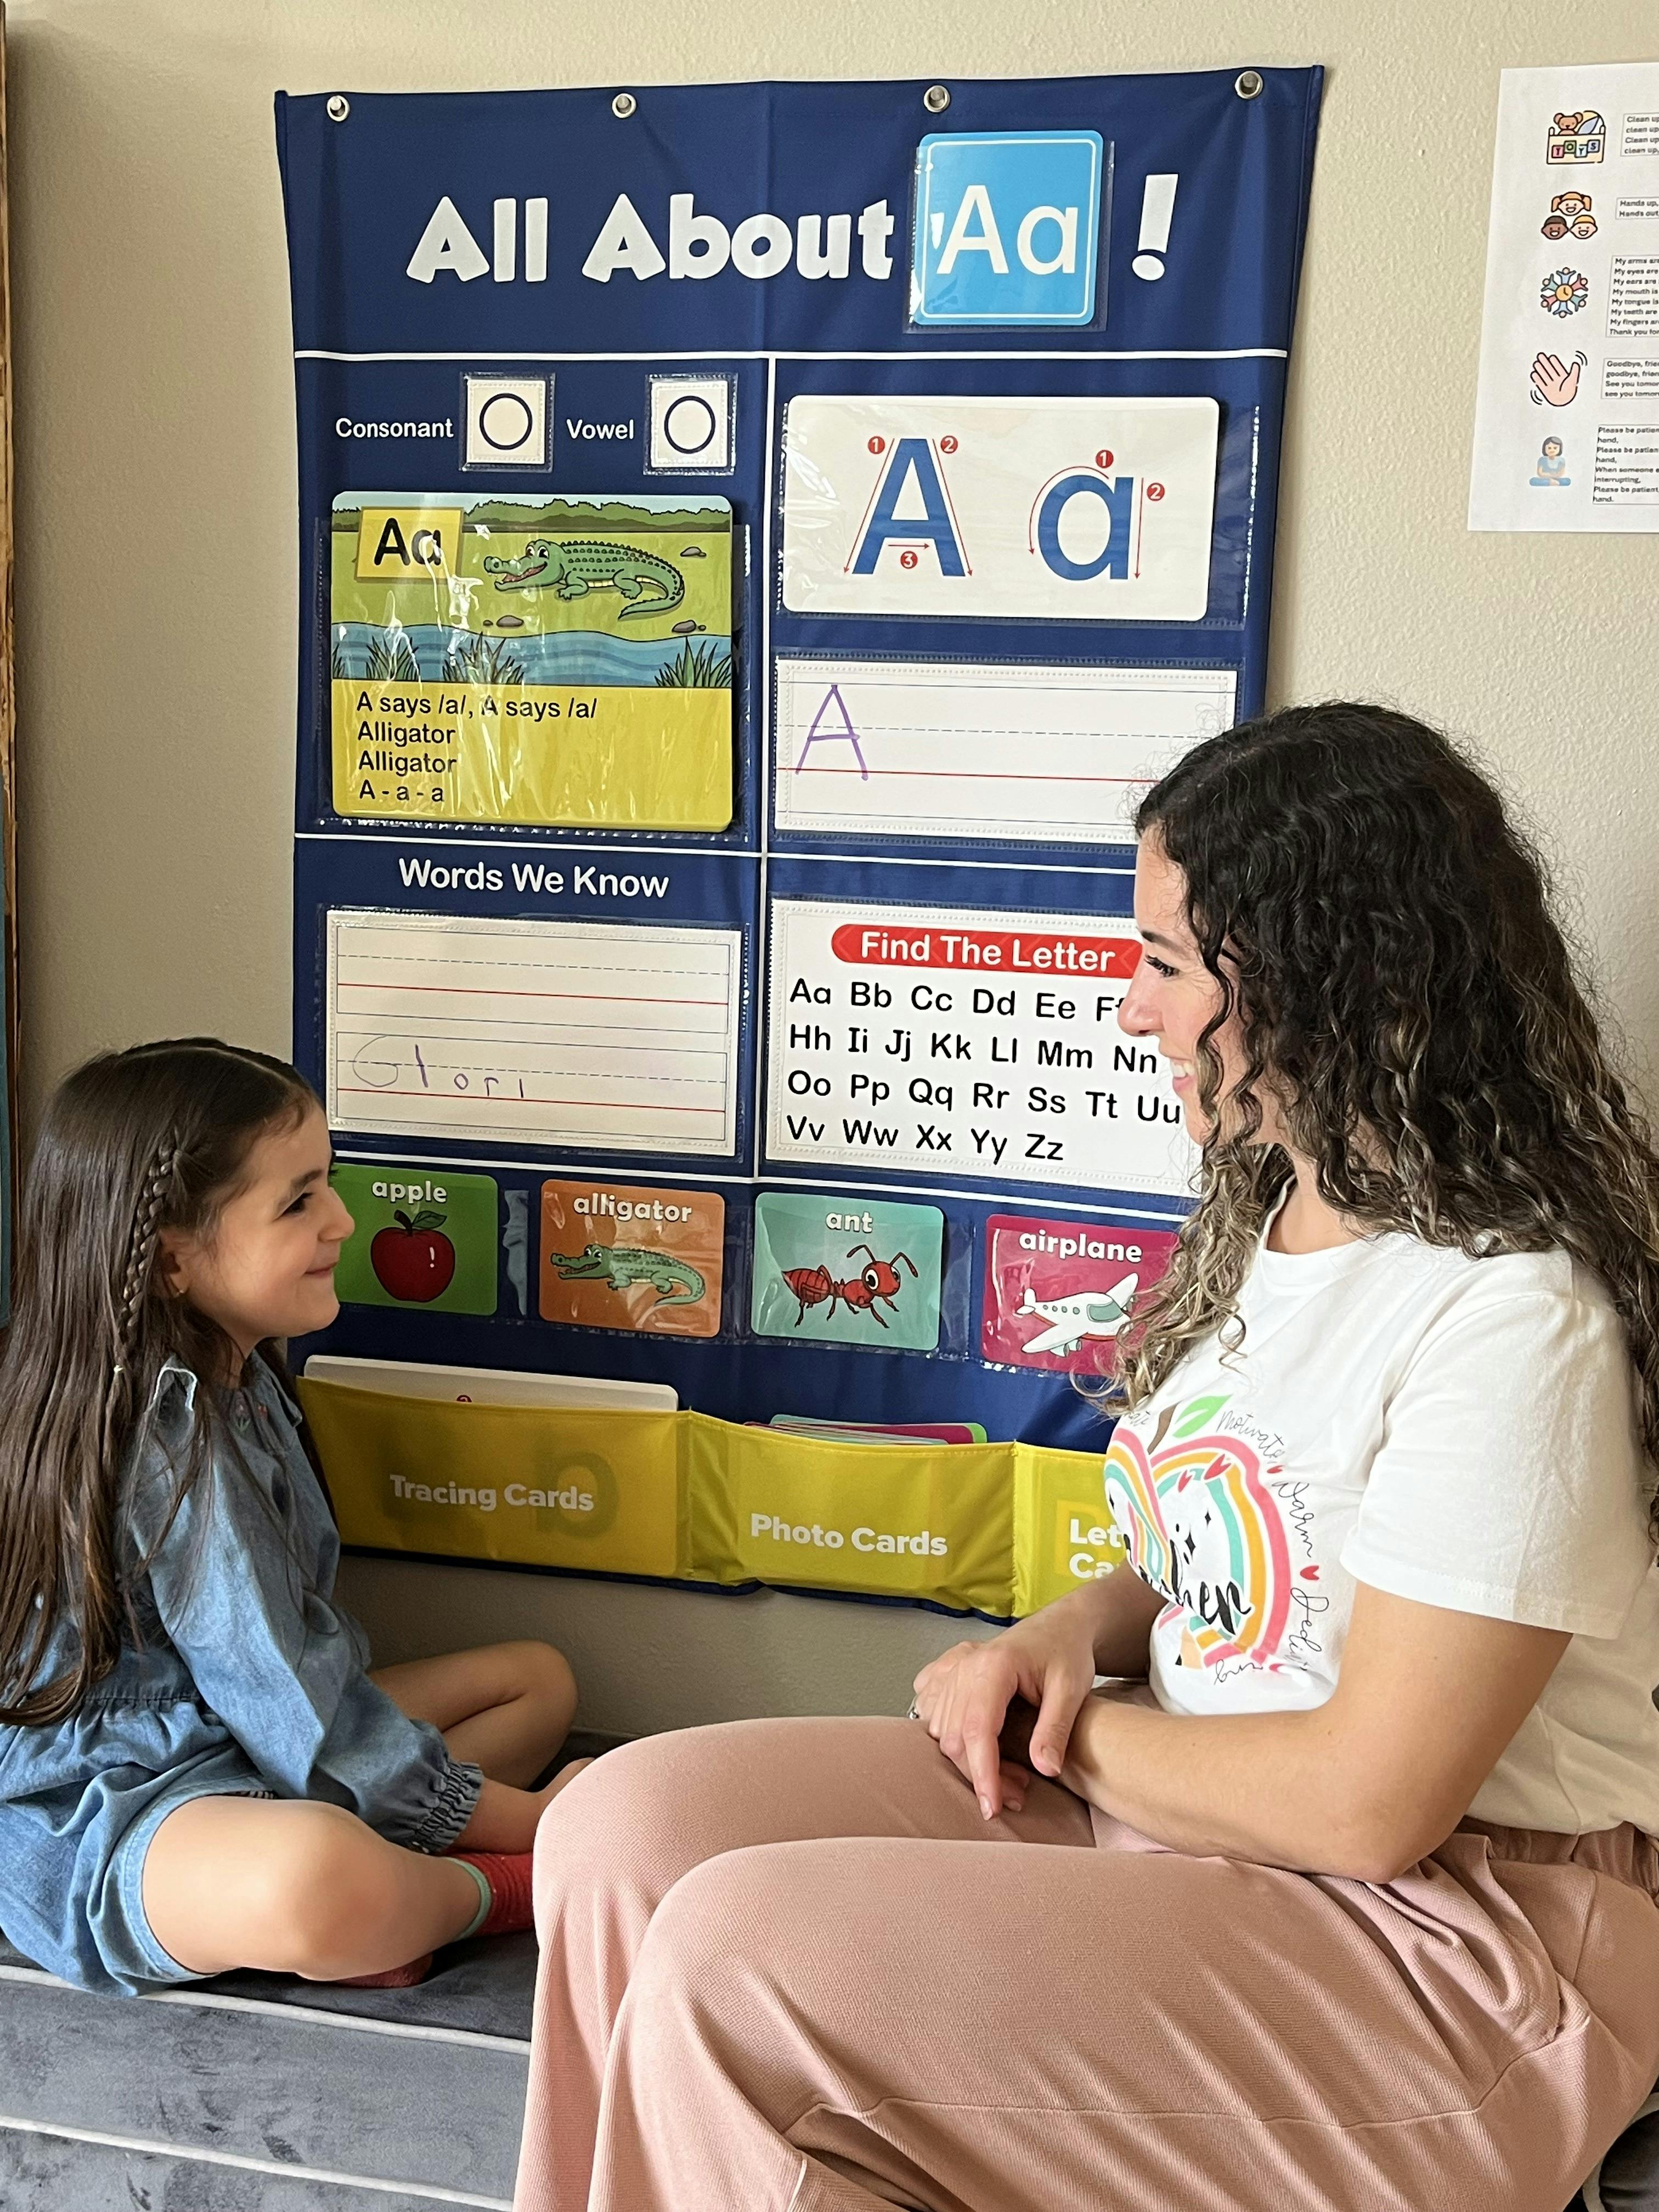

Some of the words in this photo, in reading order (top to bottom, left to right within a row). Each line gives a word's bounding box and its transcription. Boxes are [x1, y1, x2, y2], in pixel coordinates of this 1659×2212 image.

[1556, 143, 1596, 156] TOYS
[407, 196, 548, 283] All
[582, 194, 894, 283] About
[937, 185, 1078, 274] Aa
[1132, 174, 1178, 281] !
[336, 417, 454, 438] Consonant
[566, 419, 634, 441] Vowel
[852, 438, 966, 577] A
[1038, 475, 1134, 581] a
[373, 517, 442, 566] Aa
[357, 691, 373, 712] A
[380, 697, 431, 717] says
[481, 696, 499, 716] A
[506, 701, 561, 722] says
[568, 697, 597, 719] /a/
[358, 721, 456, 747] Alligator
[795, 684, 869, 780] A
[358, 750, 457, 777] Alligator
[359, 780, 376, 799] A
[396, 786, 410, 800] a
[431, 787, 445, 802] a
[399, 859, 503, 892] Words
[511, 863, 563, 893] We
[574, 866, 669, 898] Know
[860, 932, 930, 963] Find
[940, 935, 1001, 966] The
[1013, 939, 1115, 972] Letter
[790, 978, 832, 1005] Aa
[850, 982, 892, 1008] Bb
[911, 985, 953, 1012] Cc
[973, 989, 1015, 1016] Dd
[1036, 993, 1076, 1019] Ee
[789, 1025, 831, 1051] Hh
[848, 1028, 868, 1053] Ii
[885, 1030, 911, 1062] Jj
[931, 1033, 972, 1060] Kk
[991, 1037, 1017, 1063] Ll
[1038, 1041, 1093, 1069] Mm
[1114, 1045, 1156, 1074] Nn
[788, 1070, 832, 1097] Oo
[850, 1075, 890, 1106] Pp
[909, 1079, 953, 1111] Qq
[973, 1083, 1010, 1110] Rr
[1028, 1087, 1066, 1115] Ss
[1086, 1091, 1118, 1119] Tt
[1137, 1095, 1180, 1124] Uu
[787, 1115, 825, 1142] Vv
[843, 1119, 899, 1148] Ww
[916, 1124, 952, 1152] Xx
[970, 1128, 1008, 1165] Yy
[1025, 1133, 1064, 1161] Zz
[371, 1180, 448, 1204] apple
[573, 1193, 692, 1224] alligator
[826, 1211, 873, 1234] ant
[1019, 1229, 1142, 1263] airplane
[390, 1474, 497, 1512] Tracing
[504, 1483, 594, 1512] Cards
[751, 1513, 844, 1548] Photo
[851, 1527, 948, 1556] Cards
[1070, 1518, 1121, 1548] Let
